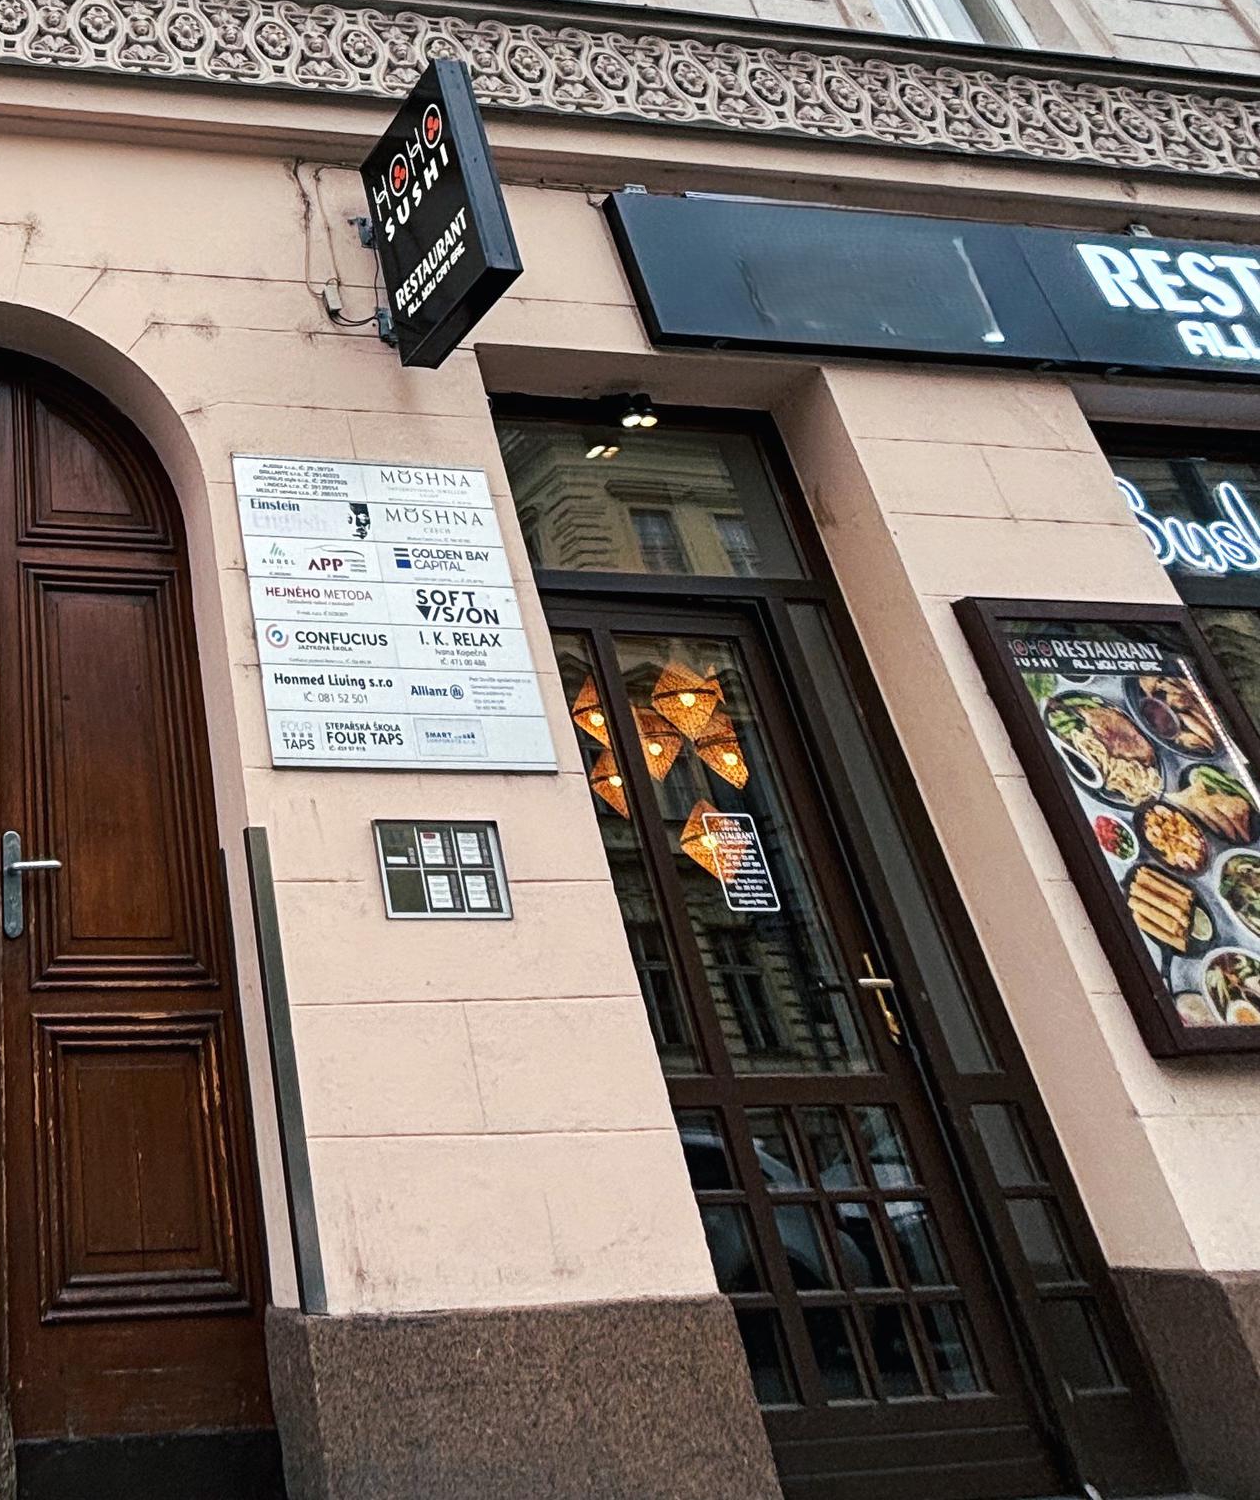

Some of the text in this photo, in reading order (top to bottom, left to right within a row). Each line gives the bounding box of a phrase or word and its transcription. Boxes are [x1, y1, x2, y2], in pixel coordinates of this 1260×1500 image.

[384, 143, 449, 243] SUSHI
[395, 207, 467, 311] RESTAURANT
[407, 297, 422, 318] ALL
[421, 277, 436, 301] YOU
[250, 498, 300, 512] Einstein
[411, 548, 490, 562] GOLDEN BAY
[308, 558, 343, 571] APP
[413, 559, 466, 572] CAPITAL
[265, 585, 373, 601] HEJNÉHO METODA
[416, 589, 475, 607] SOFT
[295, 631, 388, 646] CONFUCIUS
[419, 631, 502, 647] I. K. RELAX
[1051, 640, 1163, 660] RESTAURANT
[1072, 659, 1095, 670] ALL
[1094, 660, 1117, 670] YOU
[274, 673, 393, 689] Honmed Living s.r.o
[318, 692, 335, 703] 081
[337, 693, 349, 704] 52
[351, 694, 369, 704] 501
[410, 685, 449, 697] Allianz
[373, 721, 401, 732] ŠKOLA
[326, 731, 404, 746] FOUR TAPS
[424, 731, 452, 739] SMART
[283, 739, 316, 751] TAPS
